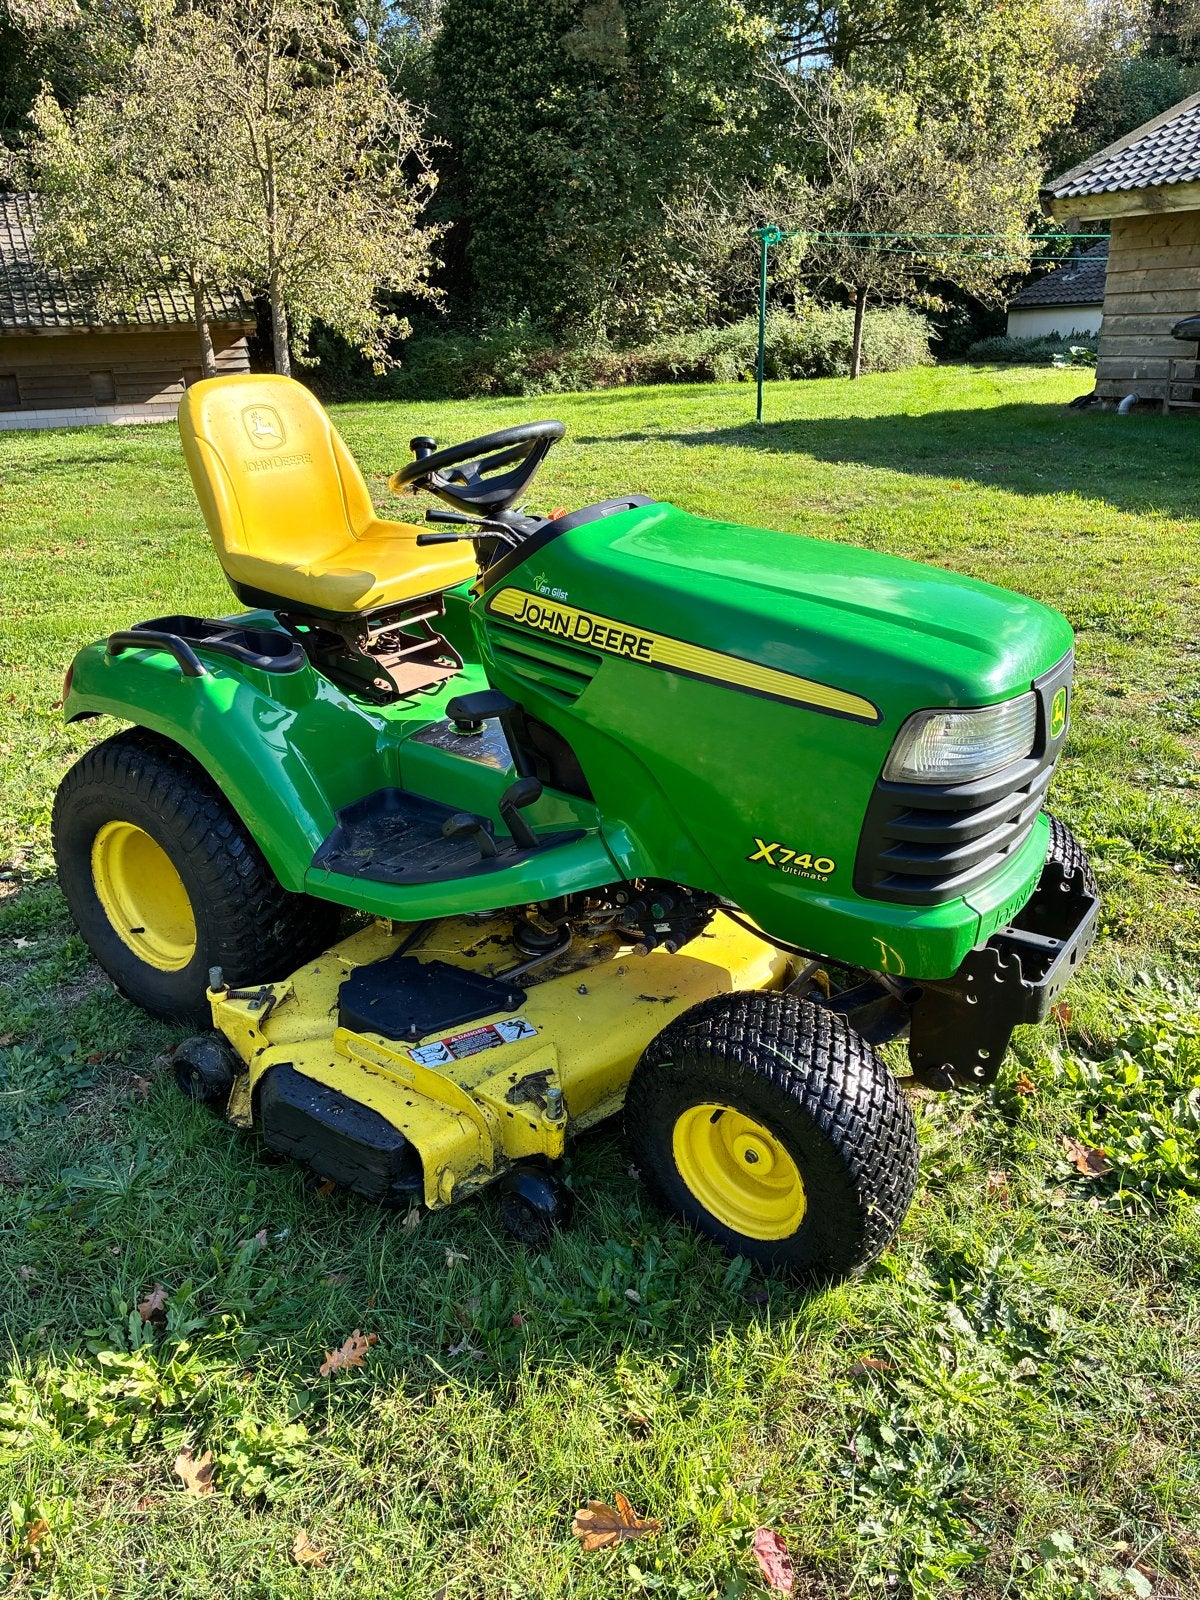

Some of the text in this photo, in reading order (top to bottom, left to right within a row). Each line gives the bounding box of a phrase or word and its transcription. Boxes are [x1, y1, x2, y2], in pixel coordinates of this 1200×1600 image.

[243, 452, 314, 473] JOHN DEERE
[534, 577, 569, 600] Van Gilst
[514, 598, 655, 660] JOHN DEERE
[748, 837, 836, 874] X740
[781, 865, 829, 882] Ultimate
[457, 1027, 488, 1040] DANGER
